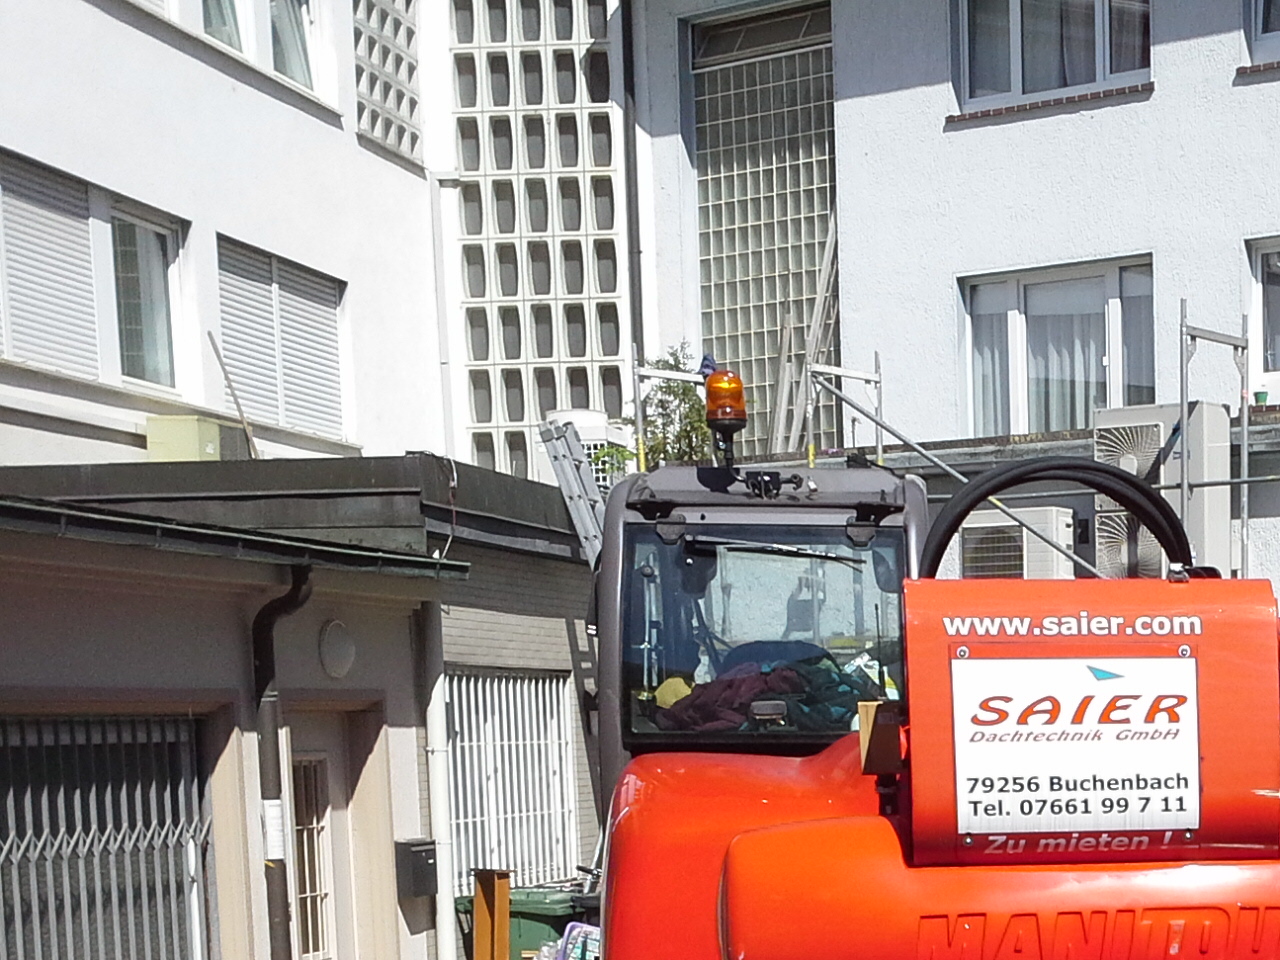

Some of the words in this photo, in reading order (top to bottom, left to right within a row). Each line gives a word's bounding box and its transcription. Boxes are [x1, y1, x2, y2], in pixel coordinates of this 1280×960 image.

[943, 611, 1202, 636] www.saier.com
[970, 695, 1188, 726] SAIER
[969, 729, 1103, 743] Dachtechnik
[1116, 728, 1181, 742] GmbH
[967, 776, 1041, 794] 79256
[1049, 774, 1189, 792] Buchenbach
[967, 799, 1011, 816] Tel.
[1020, 797, 1092, 816] 07661
[1101, 797, 1129, 813] 99
[1137, 797, 1151, 813] 7
[1161, 796, 1188, 813] 11
[984, 836, 1026, 854] Zu
[1037, 833, 1149, 853] mieten
